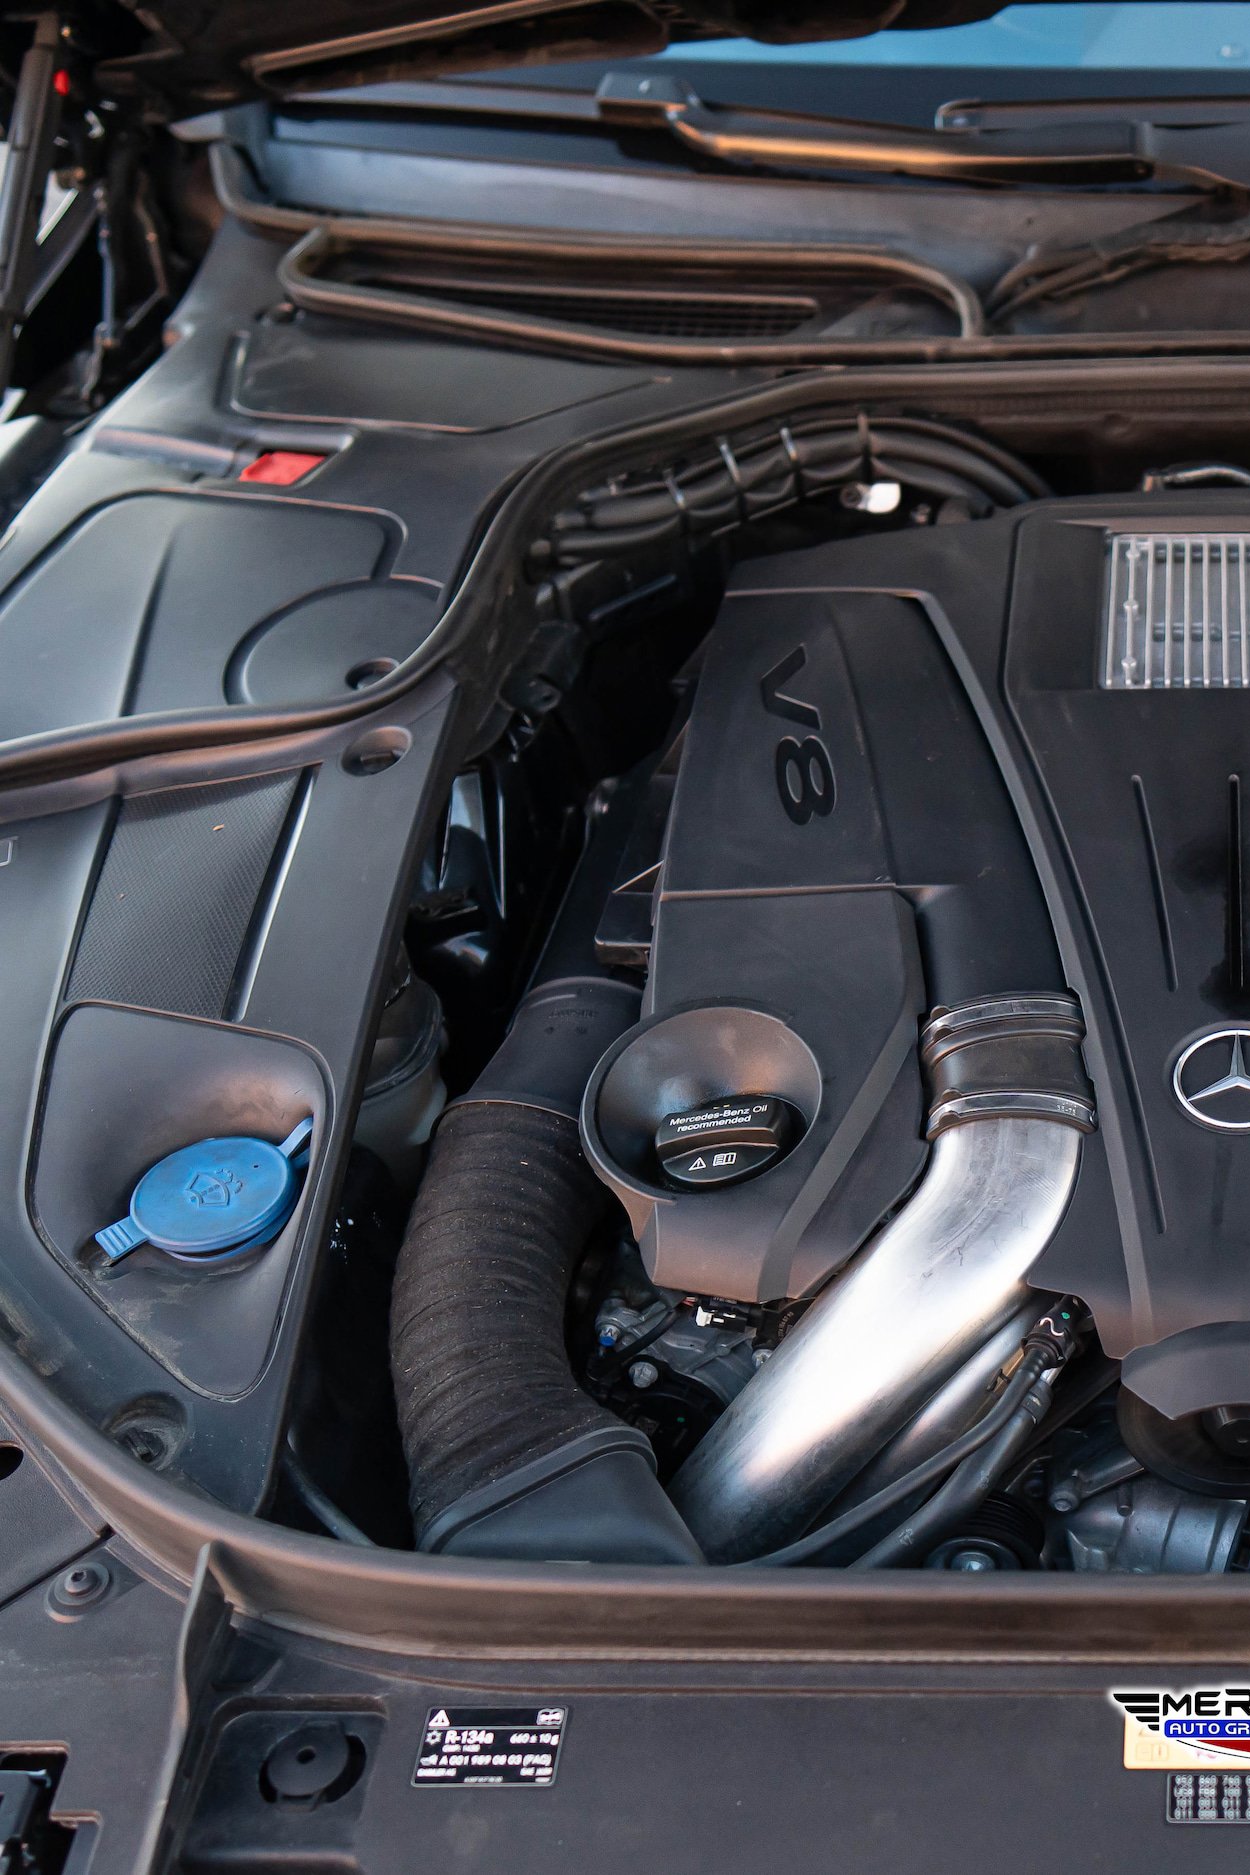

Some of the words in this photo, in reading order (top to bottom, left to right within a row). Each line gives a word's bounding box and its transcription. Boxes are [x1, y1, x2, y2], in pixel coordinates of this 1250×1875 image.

[760, 643, 837, 826] V8
[669, 1108, 750, 1126] Mercedes-Benz
[752, 1104, 768, 1113] Oil
[677, 1115, 752, 1132] recommended
[445, 1730, 494, 1744] R-134a
